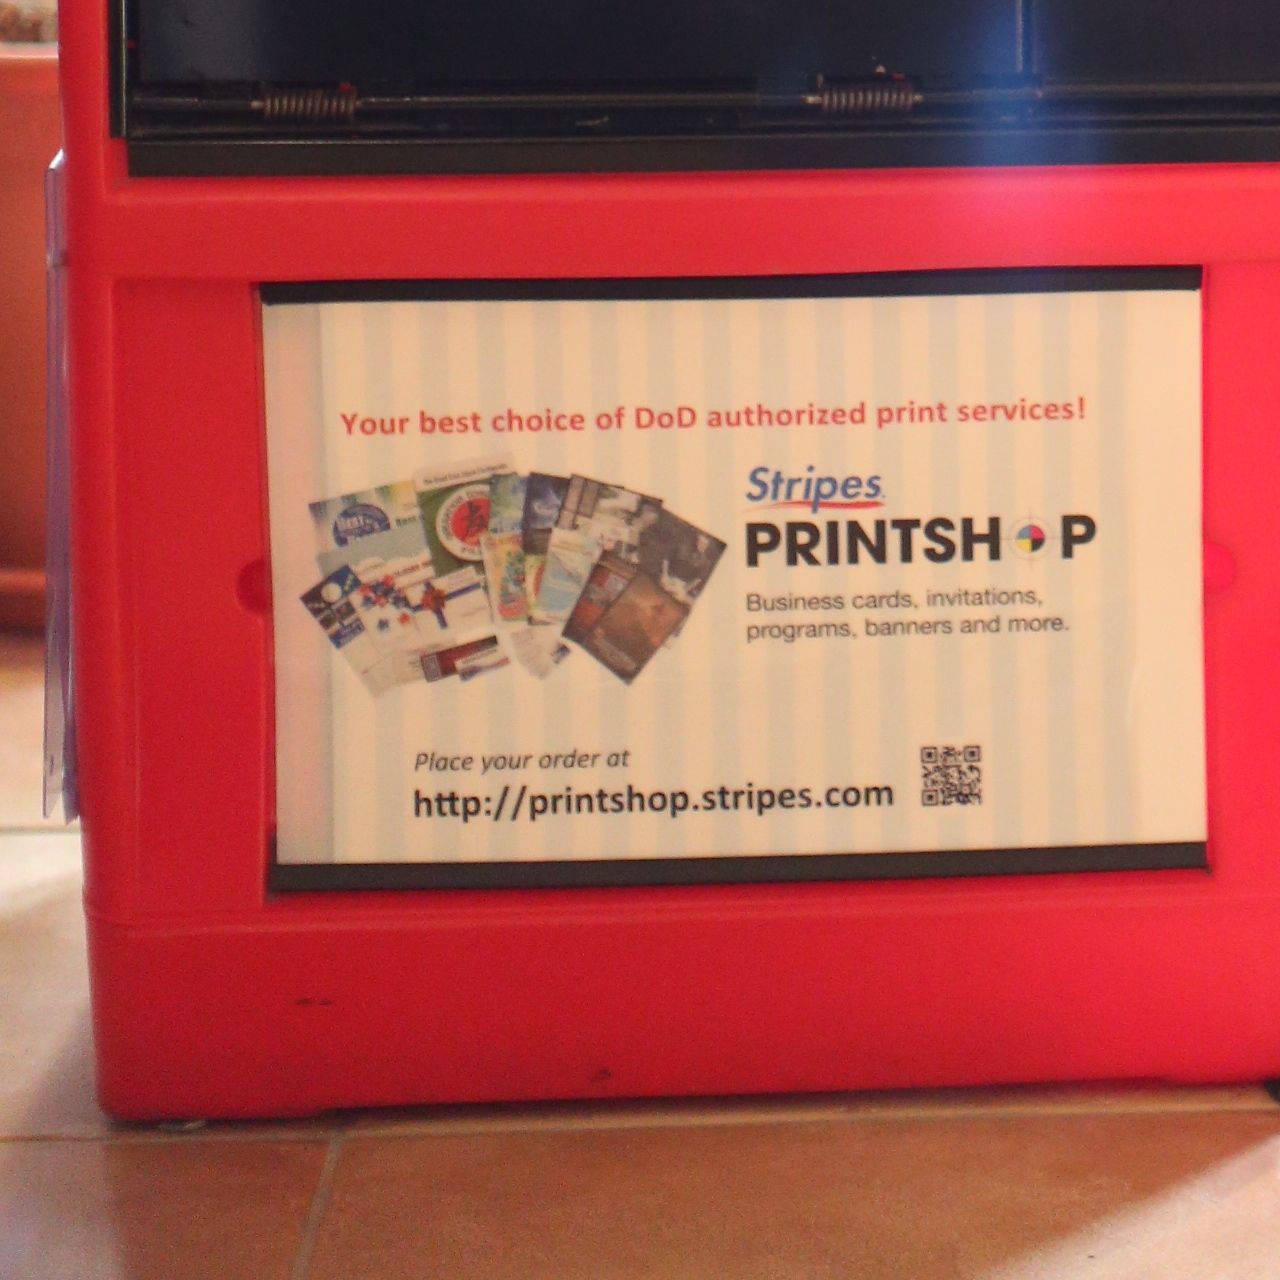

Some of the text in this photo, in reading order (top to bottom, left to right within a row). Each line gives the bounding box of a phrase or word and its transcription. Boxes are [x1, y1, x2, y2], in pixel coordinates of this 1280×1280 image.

[340, 396, 1086, 437] Your best choice of DoD authorized print services!
[745, 465, 883, 515] Stripes
[745, 587, 1044, 612] Business cards, invitations,
[745, 615, 1070, 644] programs, banners and more.
[414, 750, 631, 775] Place your order at
[413, 781, 895, 824] http://printshop.stripes.com
